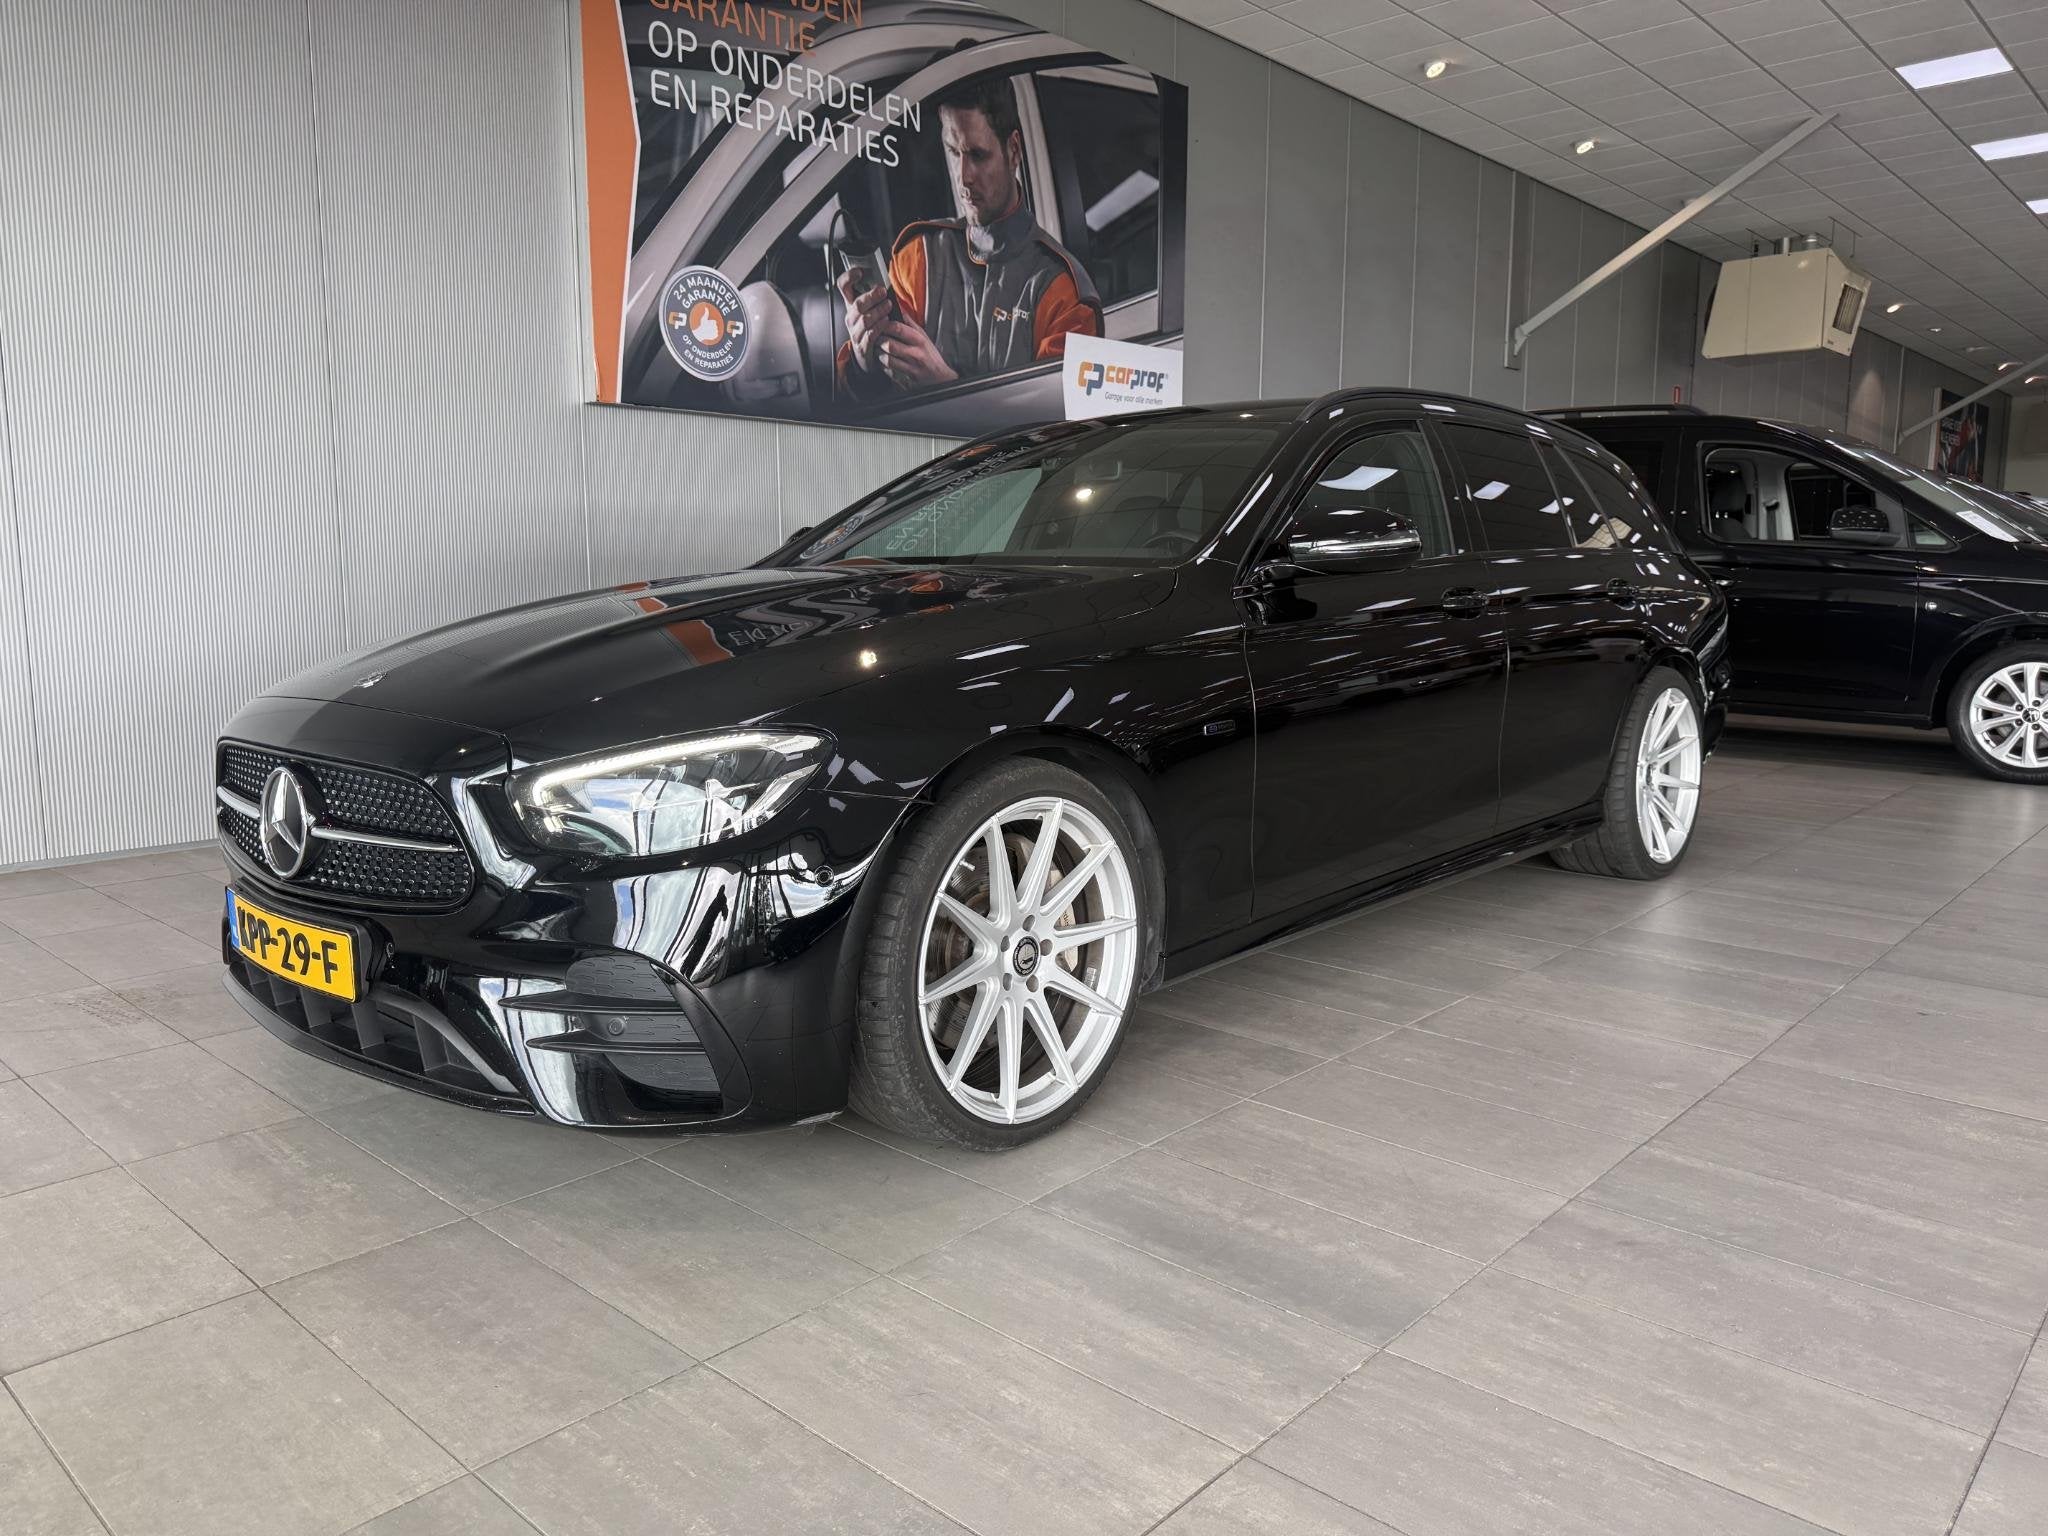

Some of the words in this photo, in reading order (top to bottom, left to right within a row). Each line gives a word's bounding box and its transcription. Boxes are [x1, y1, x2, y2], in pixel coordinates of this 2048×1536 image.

[648, 20, 698, 63] OP
[711, 39, 921, 133] ONDERDELEN
[651, 70, 697, 114] EN
[711, 85, 899, 168] REPARATIES
[673, 284, 687, 301] 24
[686, 276, 738, 311] MAANDEN
[682, 289, 731, 317] GARANTIE
[682, 334, 693, 346] OP
[691, 339, 733, 360] ONDERDELEN
[684, 349, 694, 361] EN
[694, 353, 734, 369] REPARATIES
[1105, 365, 1165, 392] carprof
[237, 906, 339, 984] KPP-29-F
